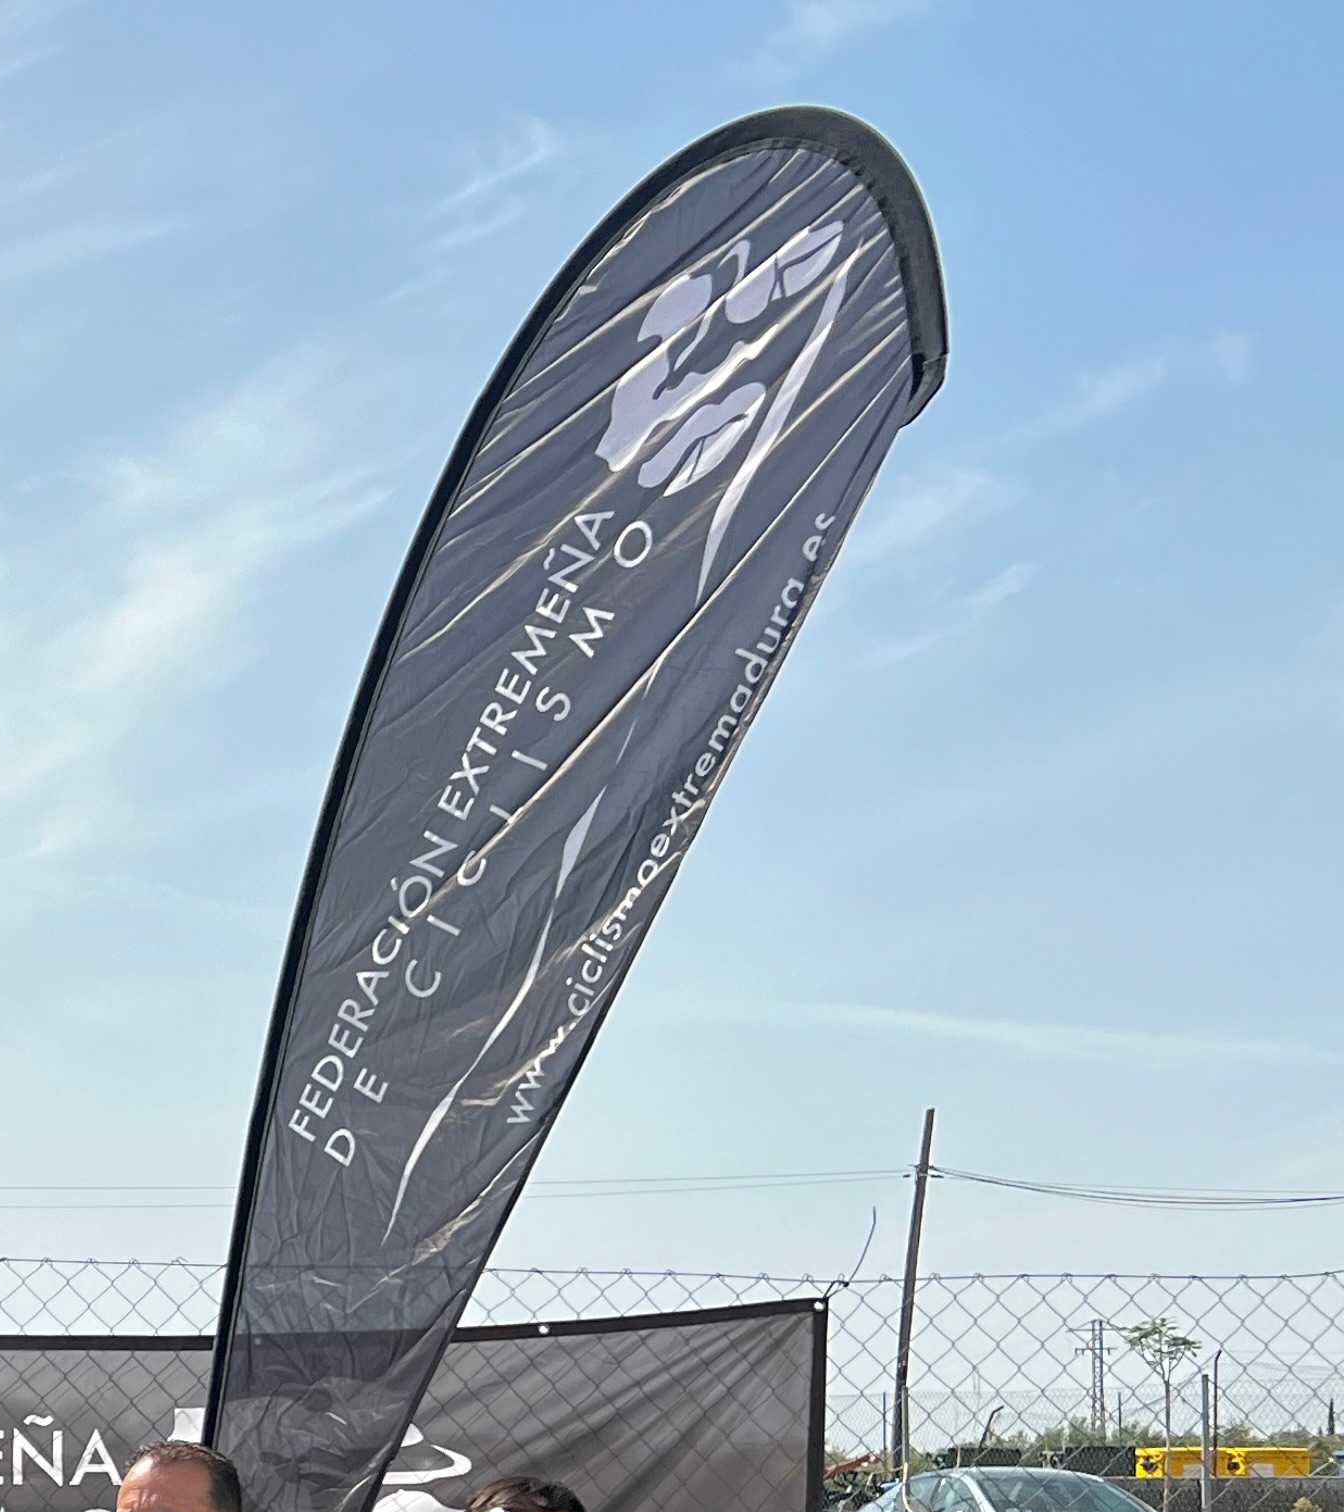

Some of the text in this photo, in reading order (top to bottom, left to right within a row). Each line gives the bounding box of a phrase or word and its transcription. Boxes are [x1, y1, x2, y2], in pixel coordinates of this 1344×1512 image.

[289, 509, 614, 1143] FEDERACIÓN EXTREMEÑA
[323, 1068, 389, 1167] DE
